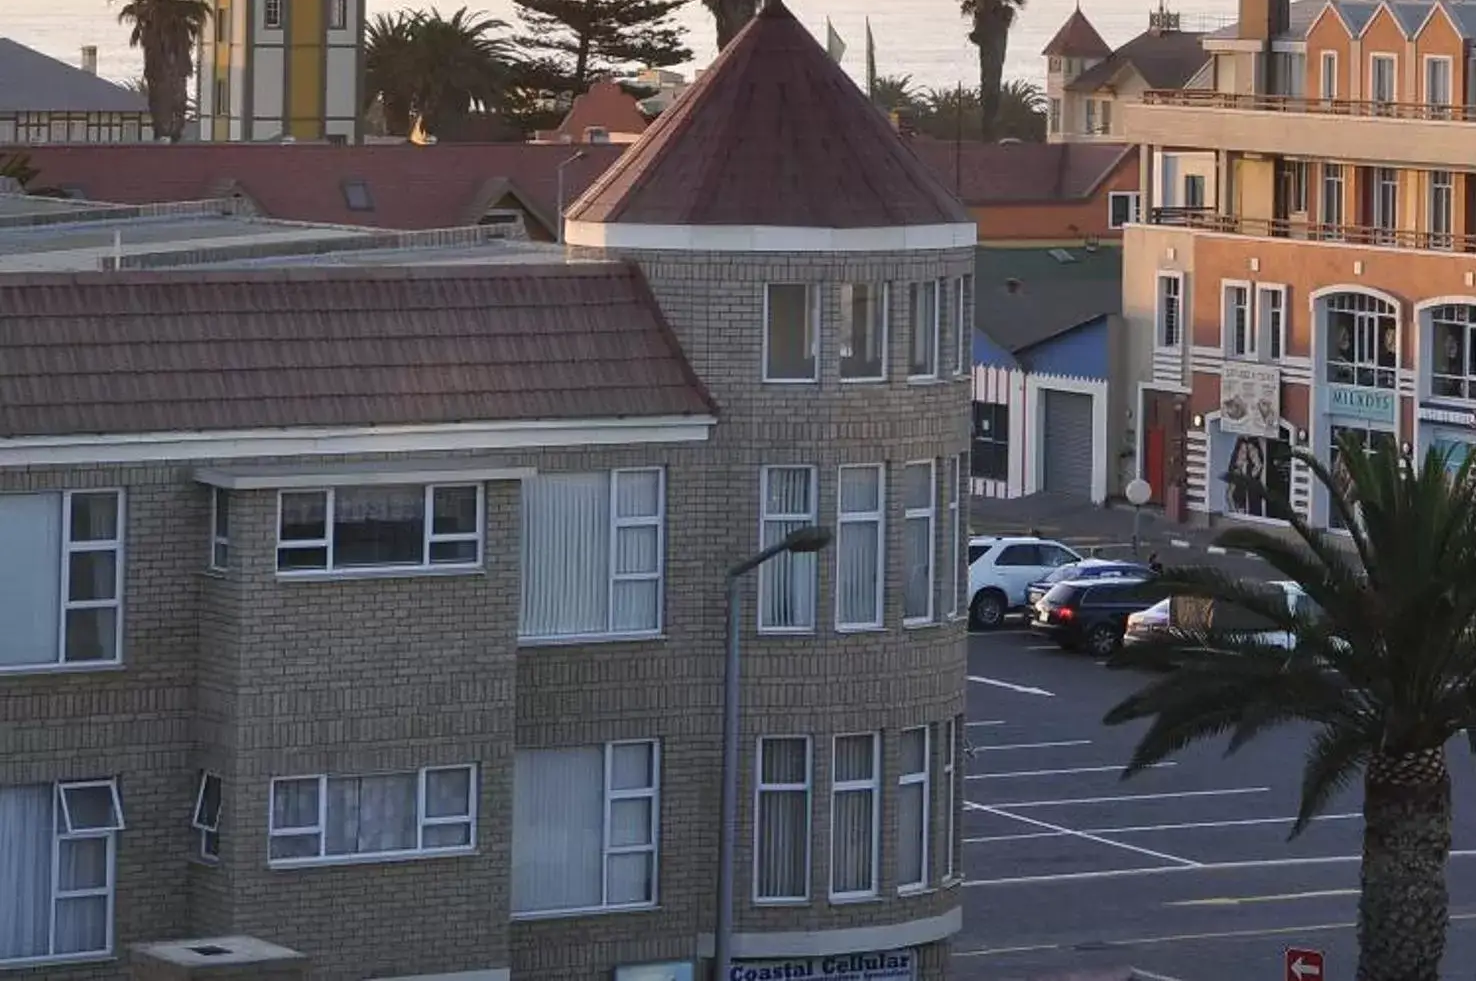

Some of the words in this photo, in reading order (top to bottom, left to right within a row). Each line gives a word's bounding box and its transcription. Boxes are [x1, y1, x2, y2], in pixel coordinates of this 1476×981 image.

[1333, 391, 1390, 410] MILADYS
[730, 961, 813, 981] Coastal
[822, 953, 910, 974] Cellular
